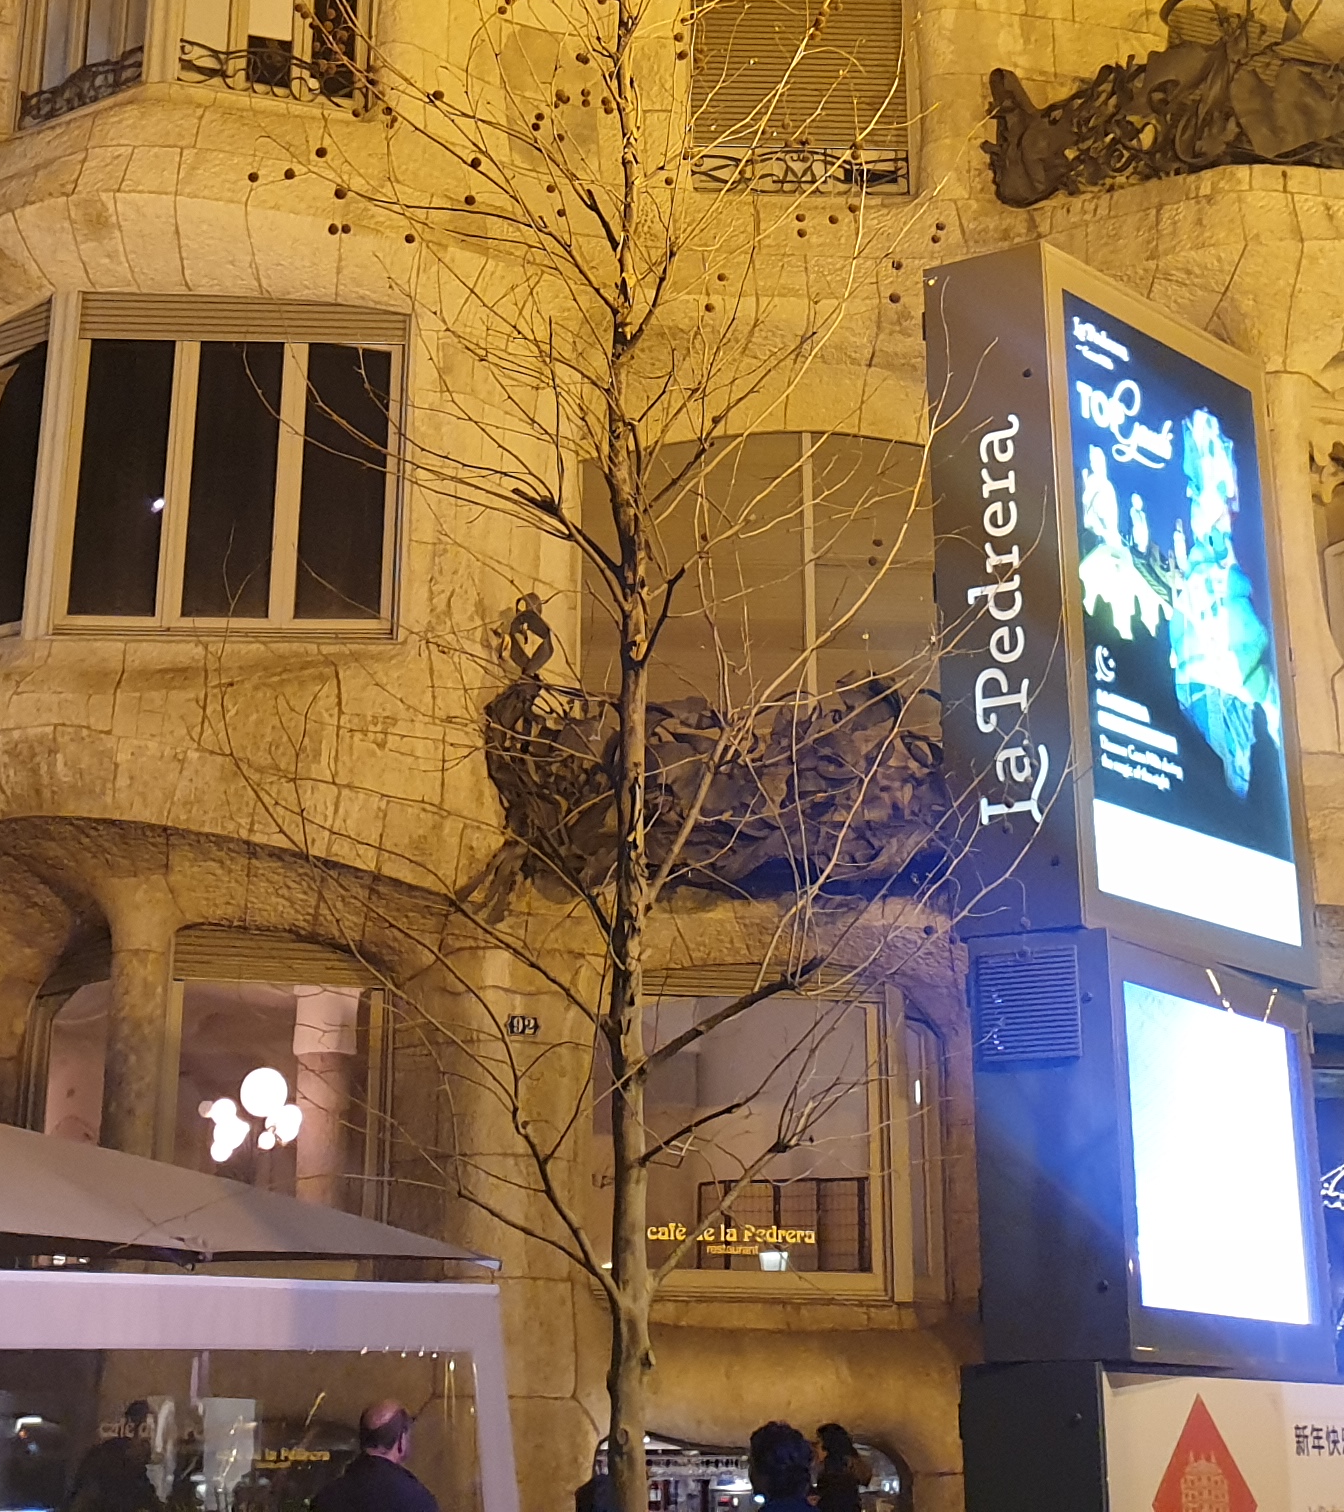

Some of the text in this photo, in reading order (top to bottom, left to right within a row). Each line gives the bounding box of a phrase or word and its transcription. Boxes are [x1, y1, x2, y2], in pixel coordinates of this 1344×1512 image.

[967, 413, 1050, 826] La Pedrera
[513, 1016, 535, 1035] 92
[647, 1222, 687, 1241] cafè
[720, 1224, 738, 1242] la
[743, 1224, 816, 1244] Pedrera
[706, 1244, 759, 1255] restaurant
